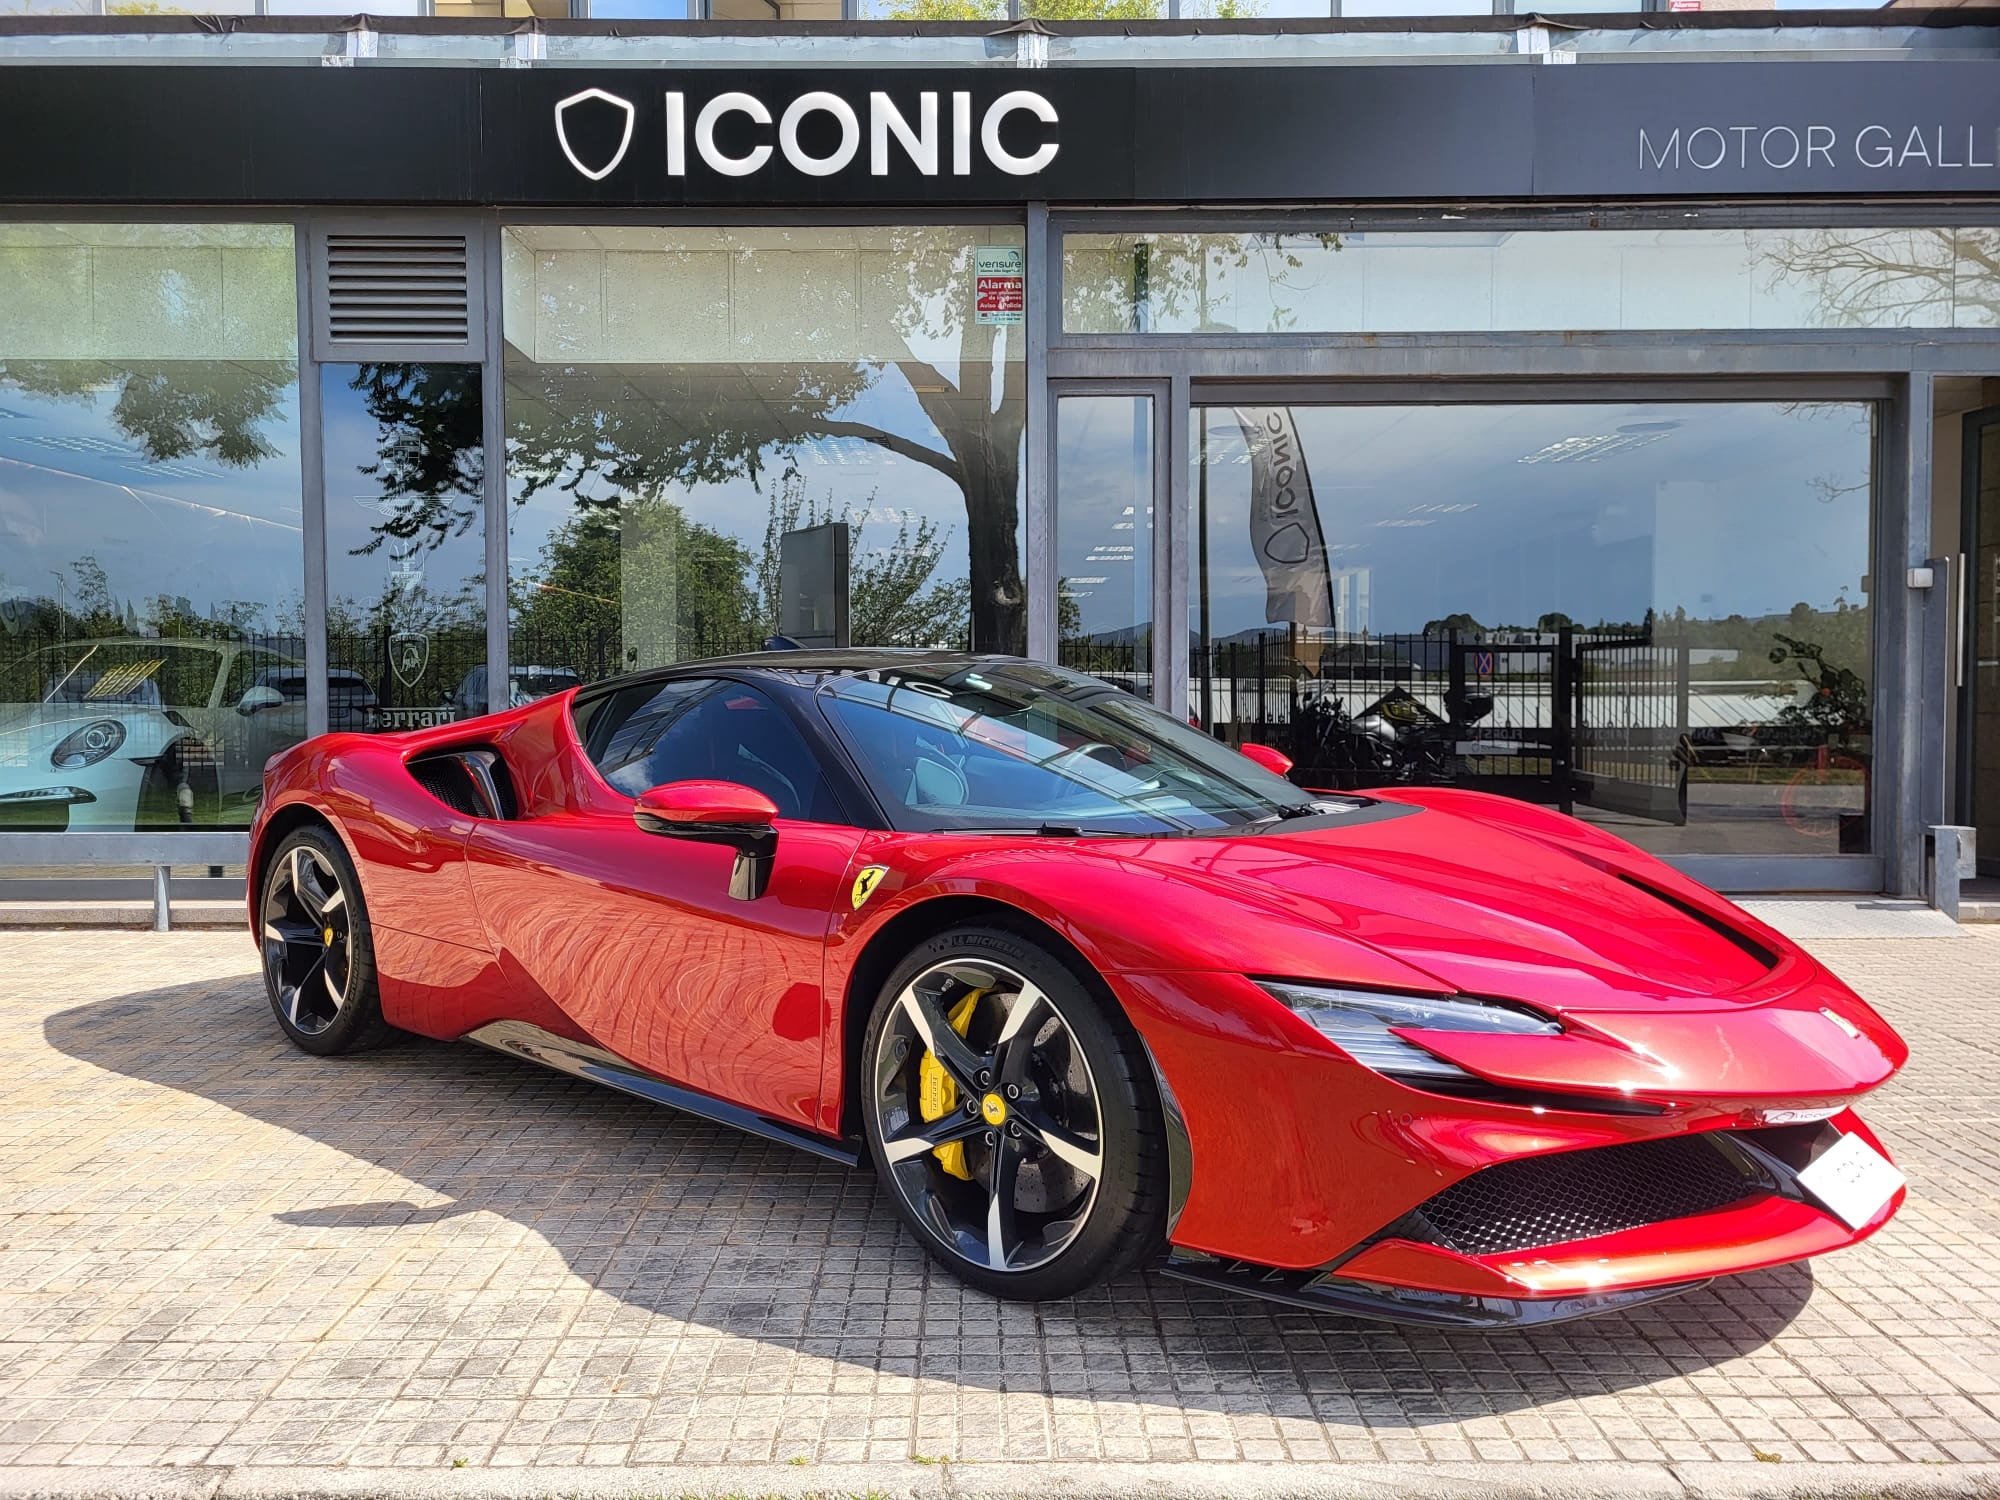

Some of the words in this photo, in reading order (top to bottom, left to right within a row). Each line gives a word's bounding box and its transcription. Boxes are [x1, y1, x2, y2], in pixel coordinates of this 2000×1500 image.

[666, 90, 1060, 177] ICONIC
[1640, 126, 1836, 169] MOTOR
[1855, 125, 2000, 168] GALL
[979, 280, 1021, 289] Alarma
[366, 707, 456, 729] Ferrari
[965, 935, 1025, 958] MICHELIN
